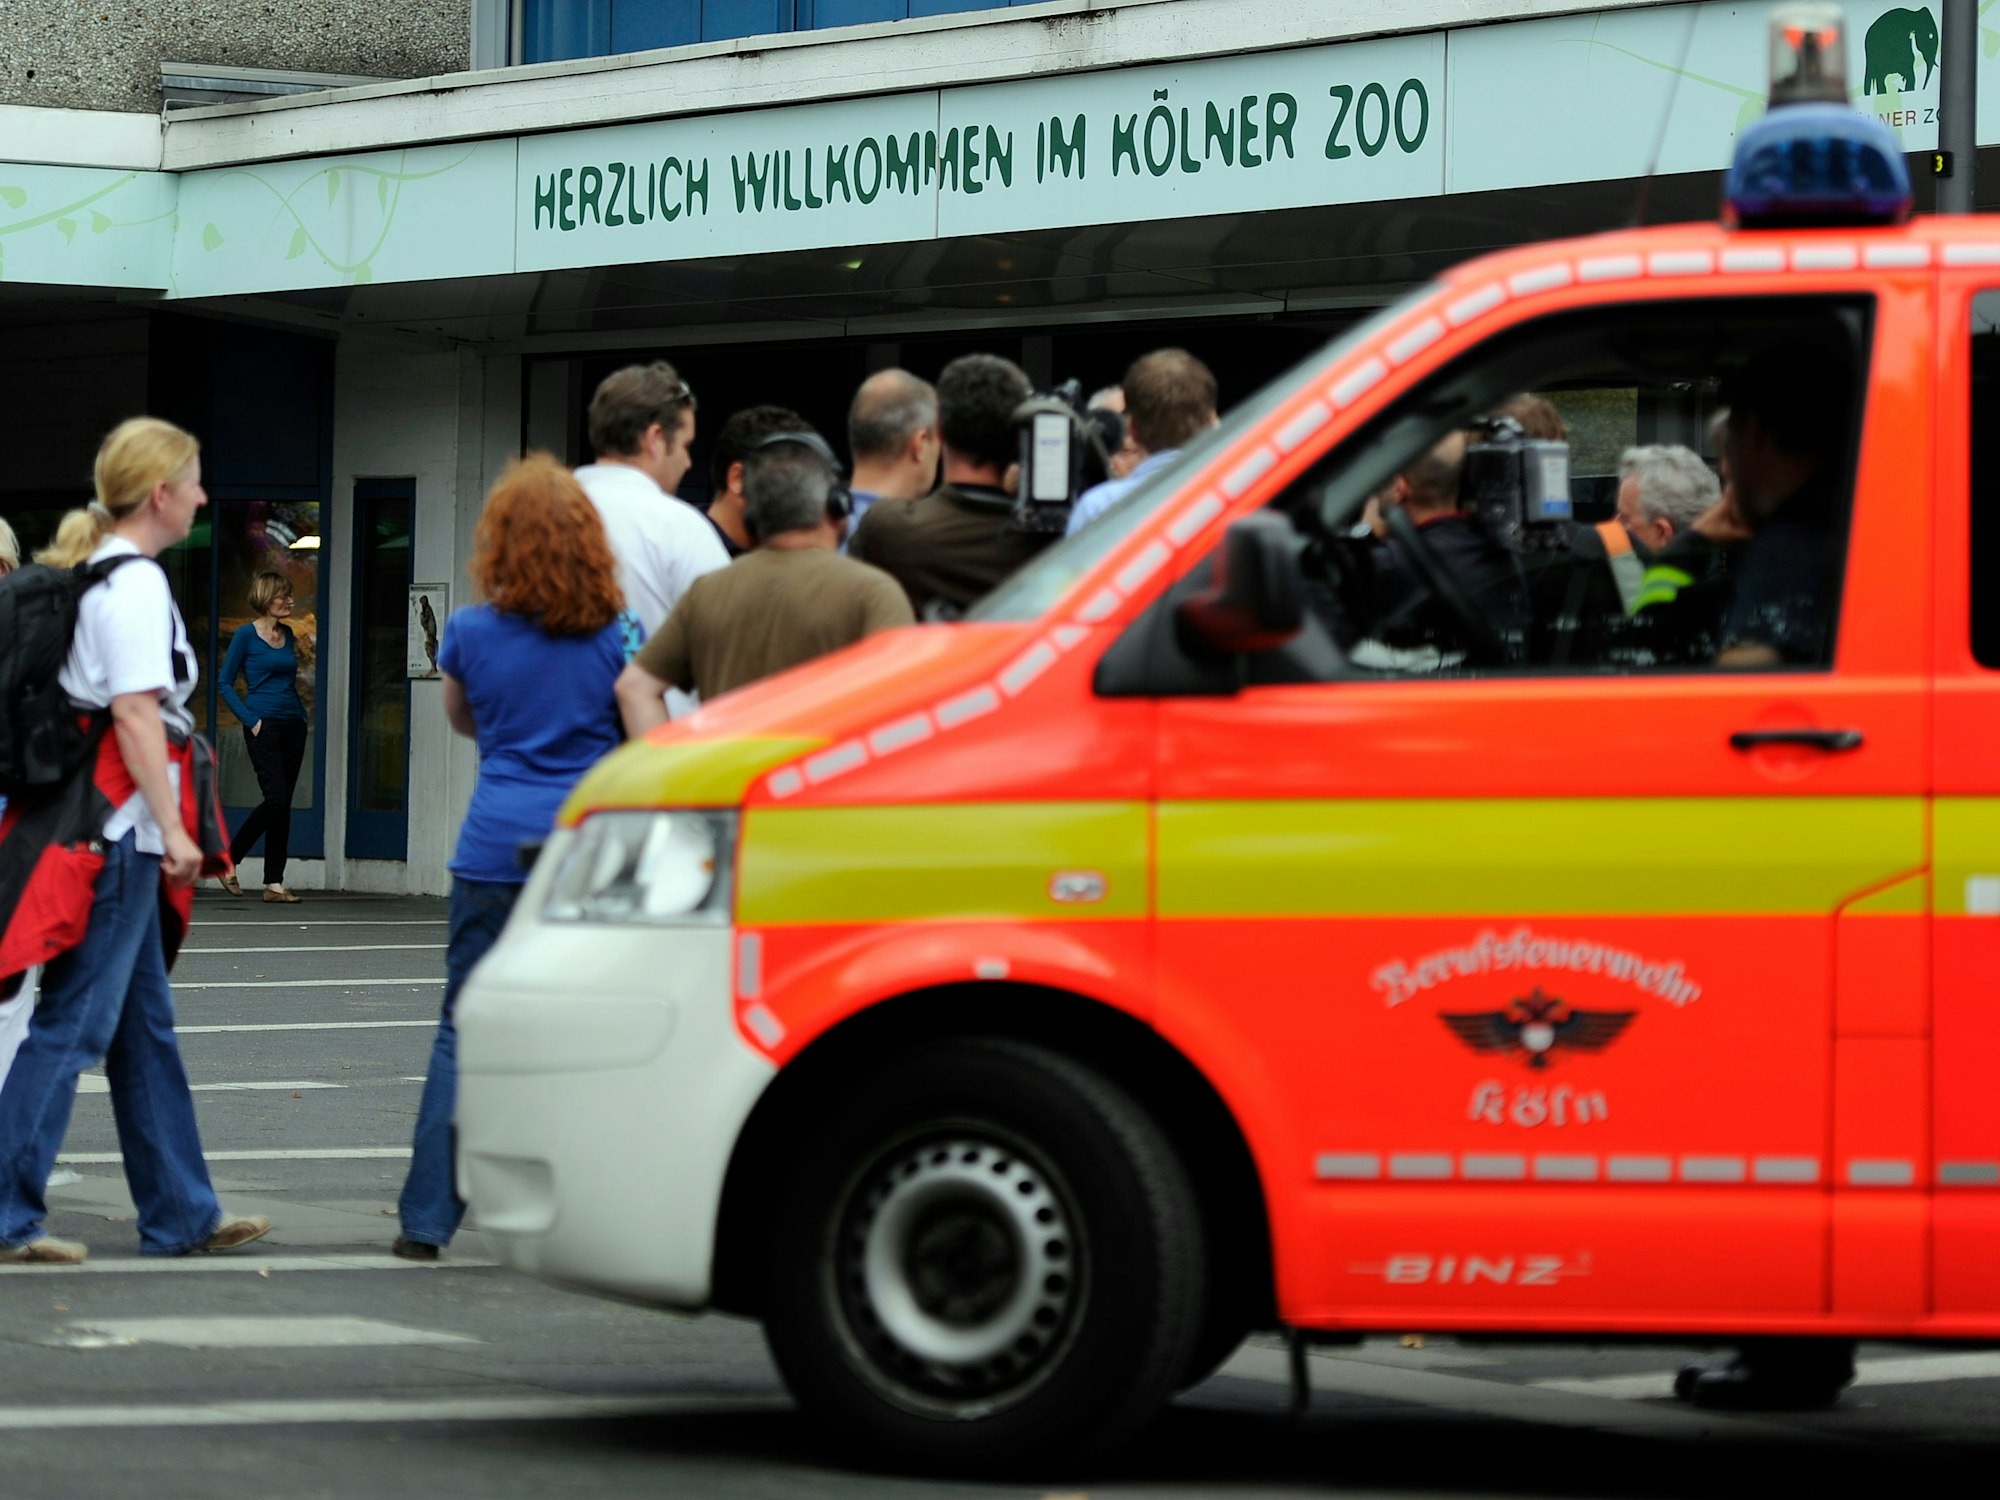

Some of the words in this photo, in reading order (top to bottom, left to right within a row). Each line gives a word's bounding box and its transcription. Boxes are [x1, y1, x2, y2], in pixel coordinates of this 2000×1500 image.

[535, 156, 709, 232] HERZLICH
[731, 124, 1013, 213] WILLKOMMEN
[1037, 113, 1086, 184] IM
[1112, 87, 1298, 177] KÖLNER
[1325, 78, 1429, 160] ZOO
[1935, 155, 1943, 172] 3
[1370, 925, 1702, 1008] Berufsfeuerwehr
[1469, 1080, 1609, 1128] Köln
[1385, 1253, 1563, 1286] BINZ
